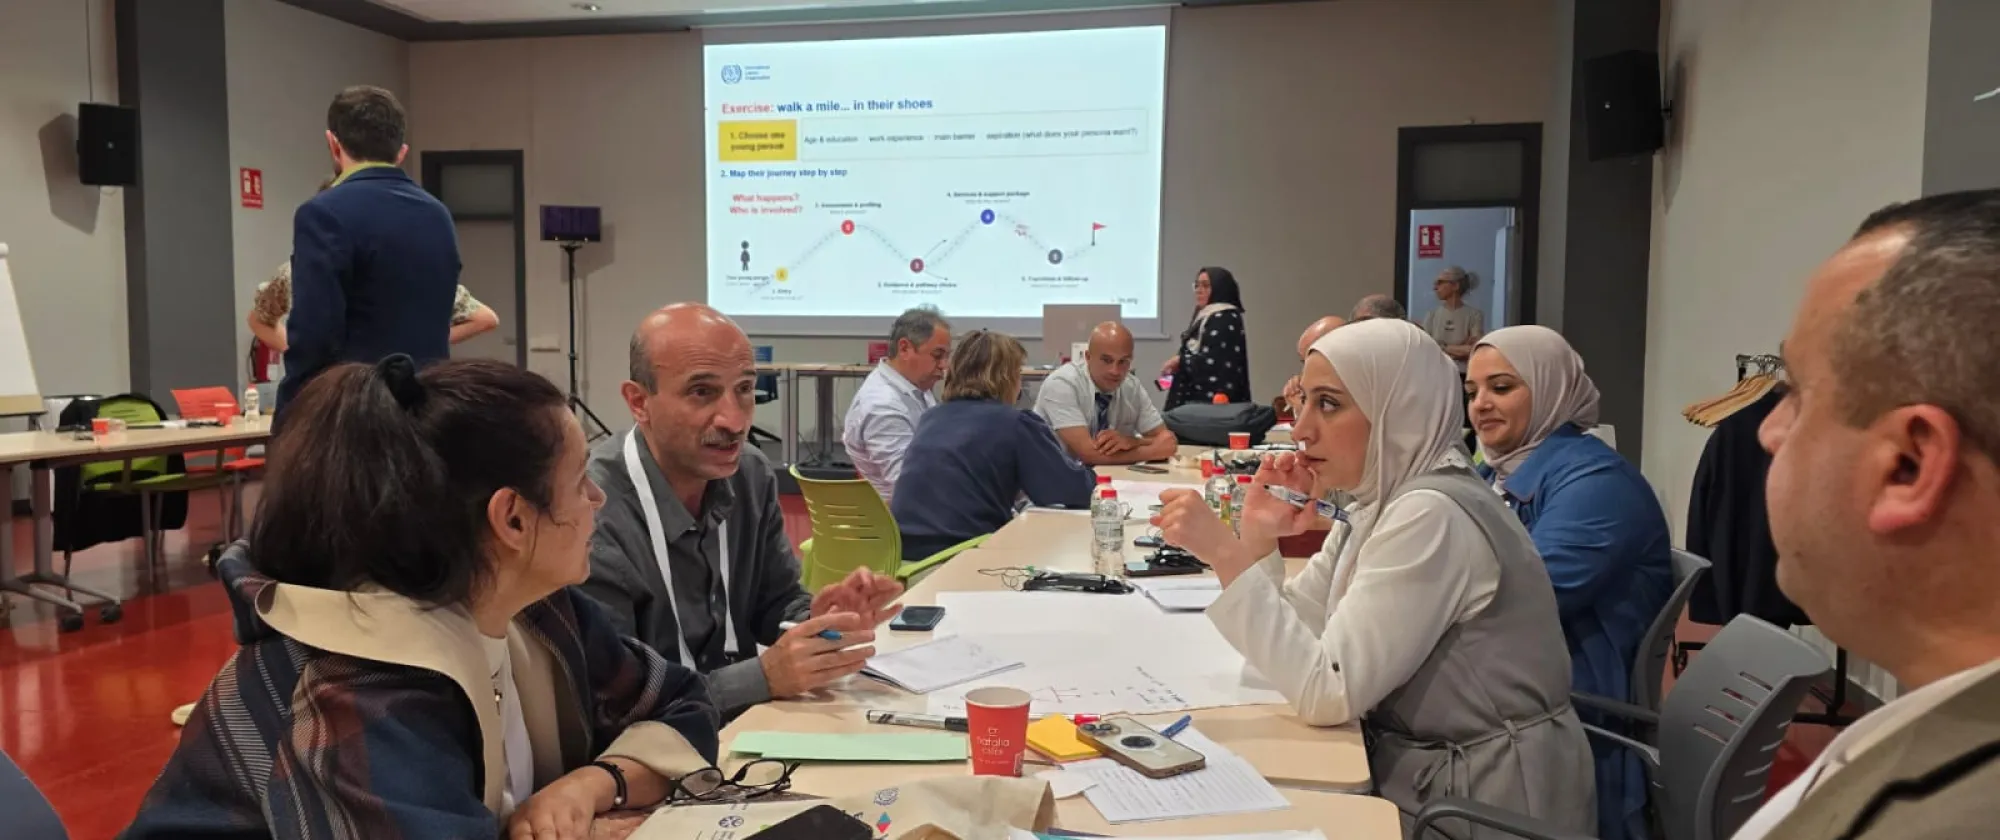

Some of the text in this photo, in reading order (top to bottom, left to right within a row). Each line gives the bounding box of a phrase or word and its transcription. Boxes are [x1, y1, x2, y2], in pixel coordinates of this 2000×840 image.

[721, 98, 933, 115] Exercise: walk a mile... in their shoes
[738, 131, 768, 140] Choose
[770, 131, 786, 139] one
[804, 136, 817, 145] Age
[1044, 130, 1061, 138] does
[1063, 130, 1080, 139] your
[729, 170, 746, 179] Map
[748, 169, 765, 177] their
[767, 169, 796, 179] journey
[799, 169, 816, 178] step
[818, 168, 828, 178] by
[829, 168, 848, 177] step
[732, 193, 800, 203] What happens?
[729, 205, 803, 214] Who is involved?
